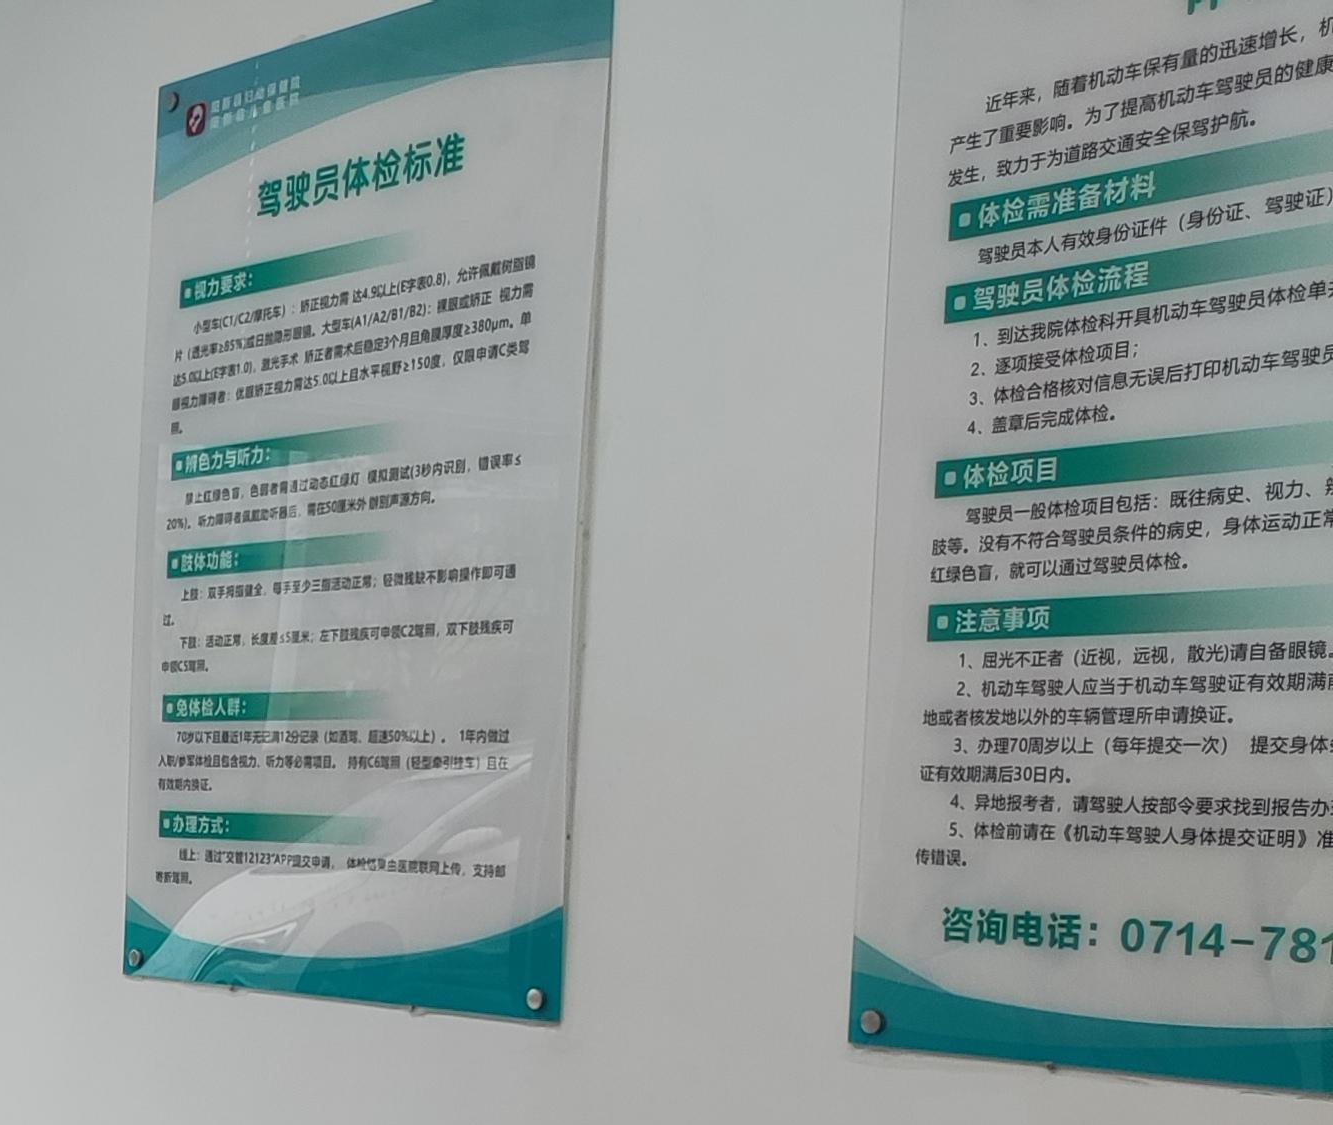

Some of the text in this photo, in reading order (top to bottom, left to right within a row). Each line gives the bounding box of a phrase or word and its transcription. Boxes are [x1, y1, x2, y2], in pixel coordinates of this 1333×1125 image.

[948, 109, 1256, 188] 发生，致力于为道路交通安全保驾护航。
[257, 132, 465, 217] 驾驶员体检标准
[978, 170, 1156, 230] 体检需准备材料
[194, 271, 253, 300] 视力要求：
[973, 260, 1149, 311] 驾驶员体检流程
[974, 279, 1333, 347] 1、到达我院体检科开具机动车驾驶员体检单
[967, 403, 1115, 435] 4、盖章后完成体检。
[185, 445, 270, 473] 辨色力与听力：
[963, 456, 1058, 489] 体检项目
[181, 550, 239, 573] 肢体功能：
[930, 552, 1188, 583] 红绿色盲，就可以通过驾驶员体检。
[955, 606, 1050, 634] 注意事项
[957, 671, 1333, 698] 2、机动车驾驶人应当于机动车驾驶证有效期满
[176, 697, 247, 718] 免体检人群：
[922, 705, 1234, 727] 地或者核发地以外的车辆管理所申请换证。
[920, 765, 1071, 784] 证有效期满后30日内。
[950, 793, 1333, 817] 4、异地报考者，请驾驶人按部令要求找到报告办
[172, 815, 230, 834] 办理方式：
[915, 849, 967, 867] 传错误。
